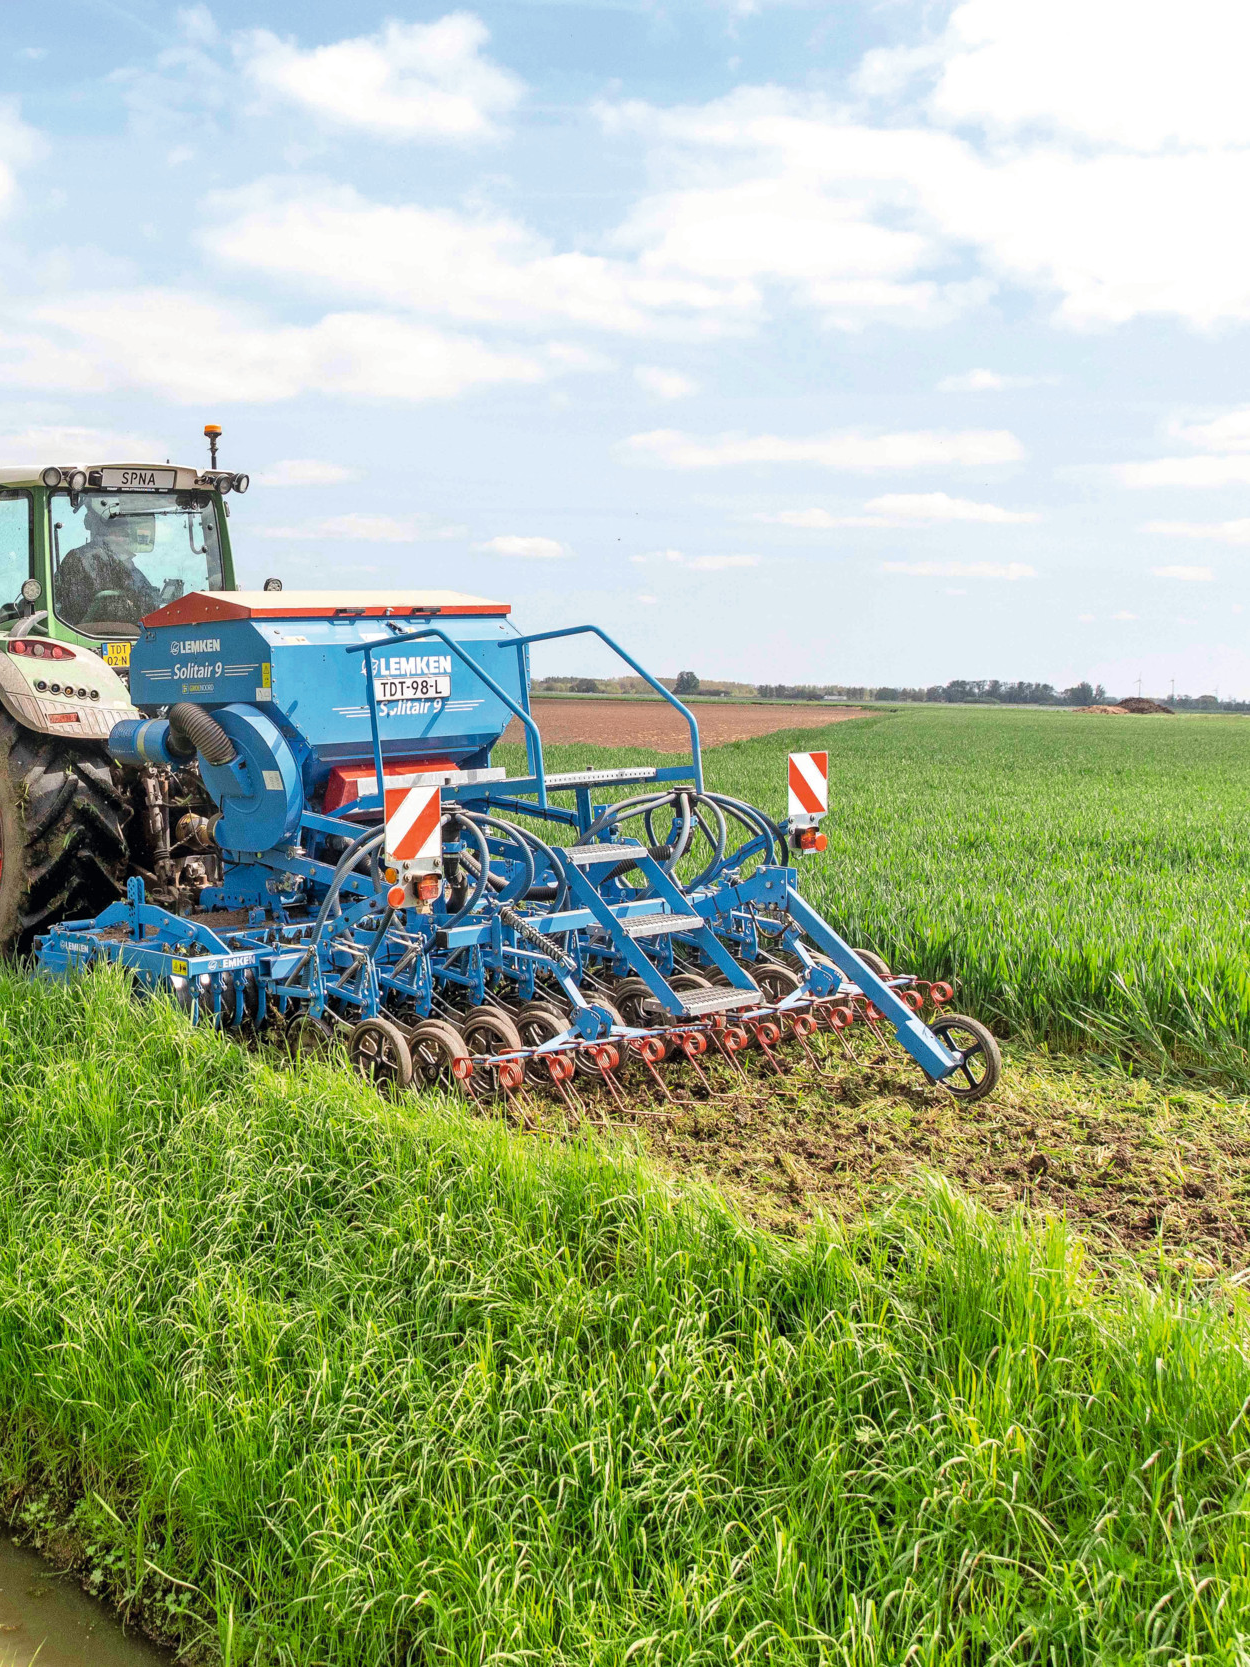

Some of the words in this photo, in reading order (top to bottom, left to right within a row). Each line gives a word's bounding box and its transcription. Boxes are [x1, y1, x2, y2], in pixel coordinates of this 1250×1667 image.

[121, 471, 156, 486] SPNA
[110, 644, 127, 655] TDT
[180, 639, 221, 655] LEMKEN
[173, 662, 212, 680] Solitair
[215, 662, 223, 678] 9
[380, 655, 452, 677] LEMKEN
[380, 679, 442, 698] TDT-98-L
[433, 698, 442, 713] 9
[218, 955, 256, 969] LEMKEN
